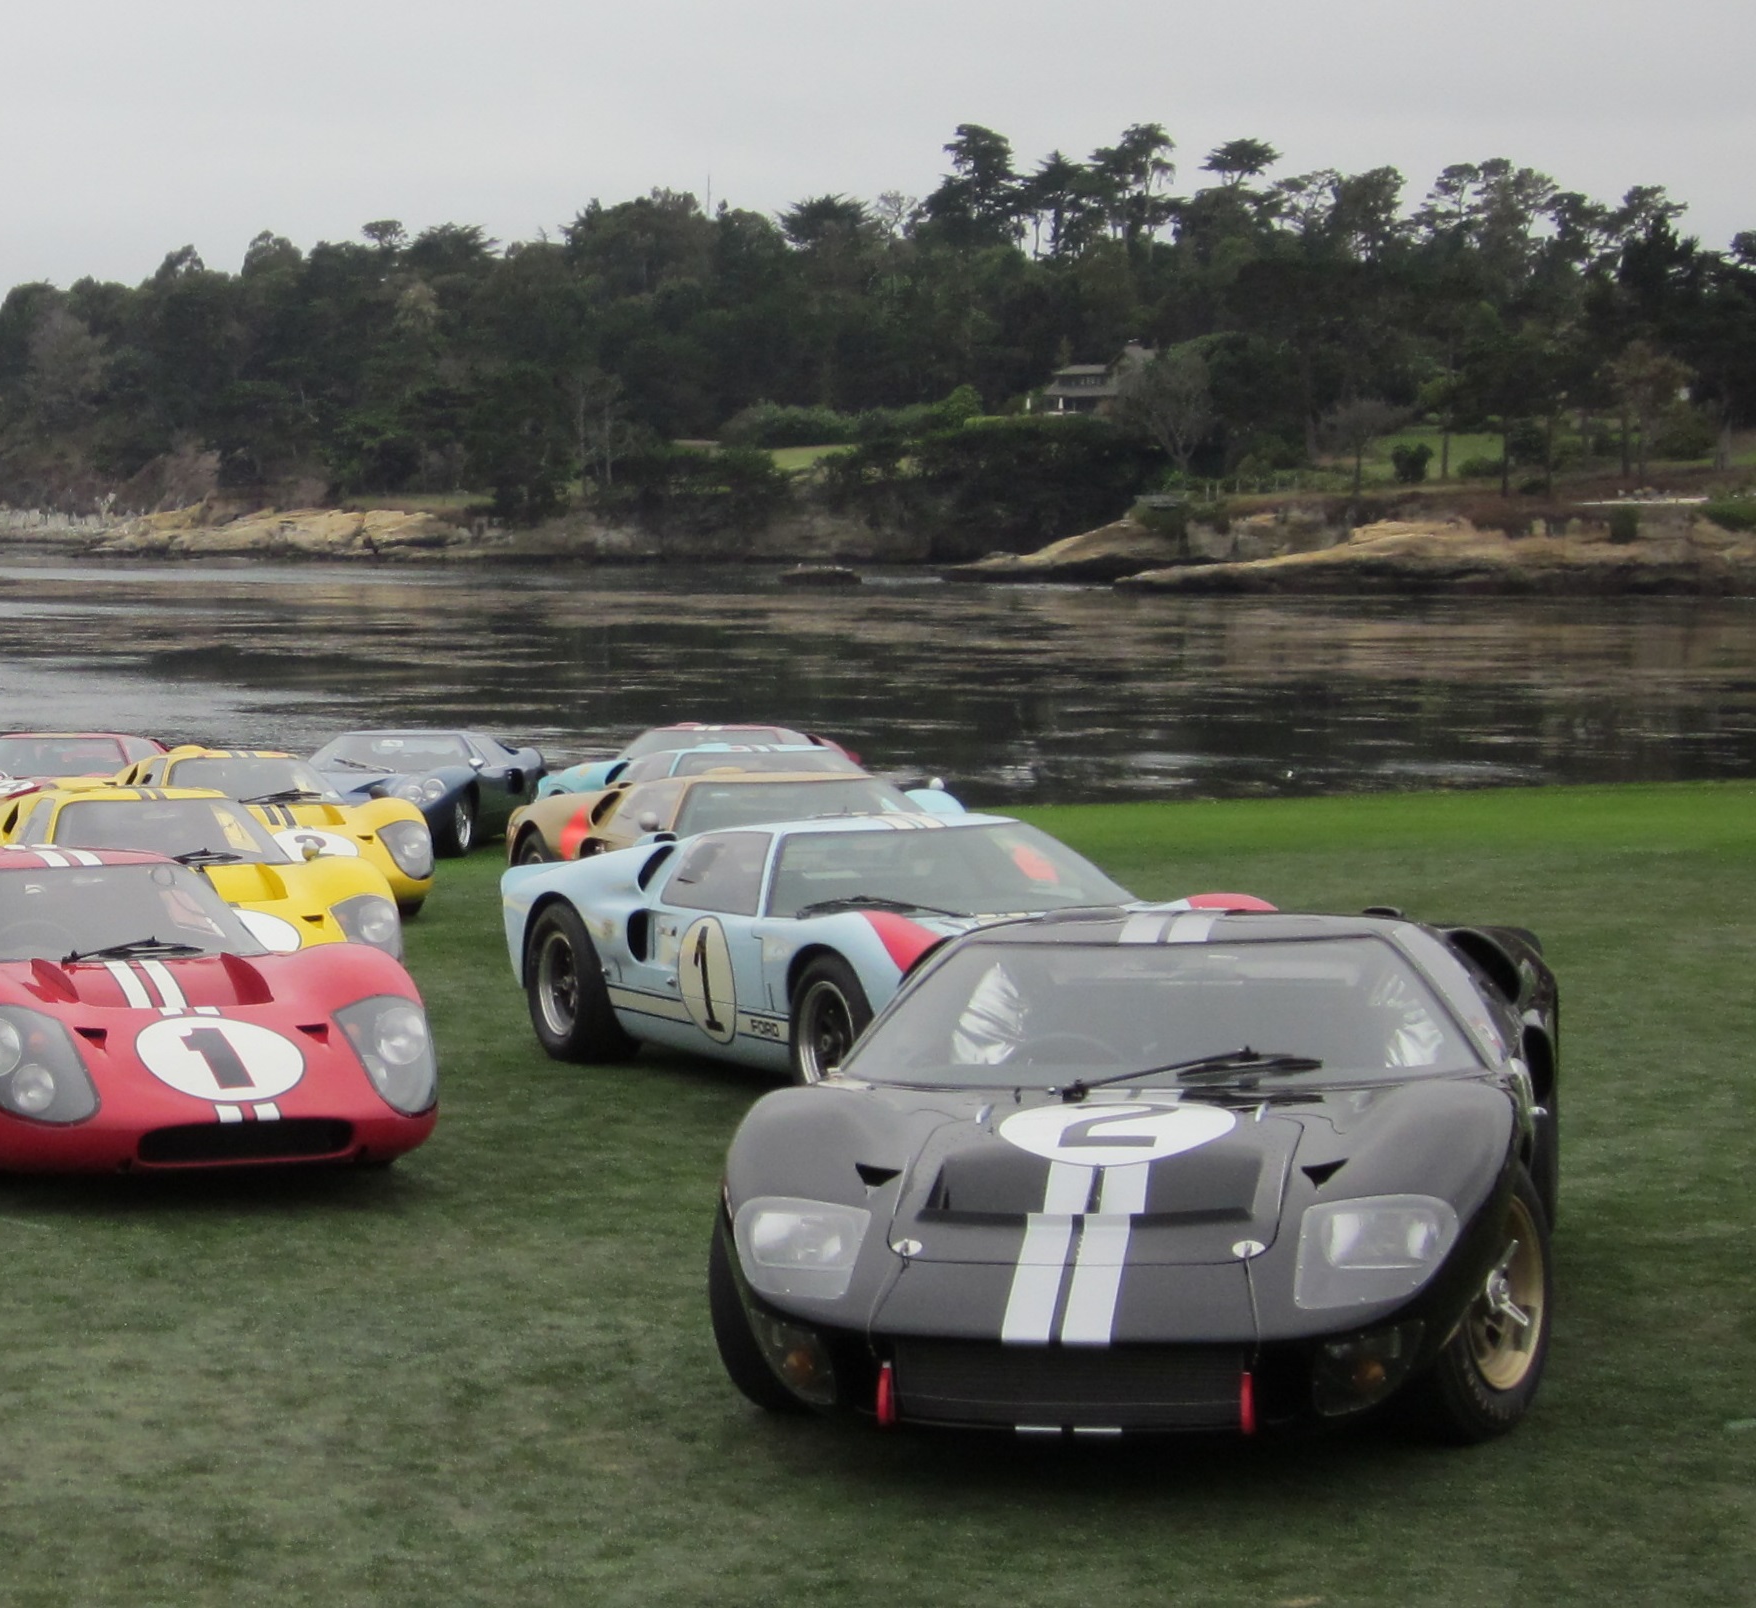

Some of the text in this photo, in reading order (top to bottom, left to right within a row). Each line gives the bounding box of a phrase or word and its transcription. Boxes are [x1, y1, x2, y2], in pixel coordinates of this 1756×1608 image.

[693, 926, 726, 1033] 1
[750, 1018, 780, 1038] FORD
[180, 1027, 256, 1090] 1
[1056, 1102, 1180, 1148] 2
